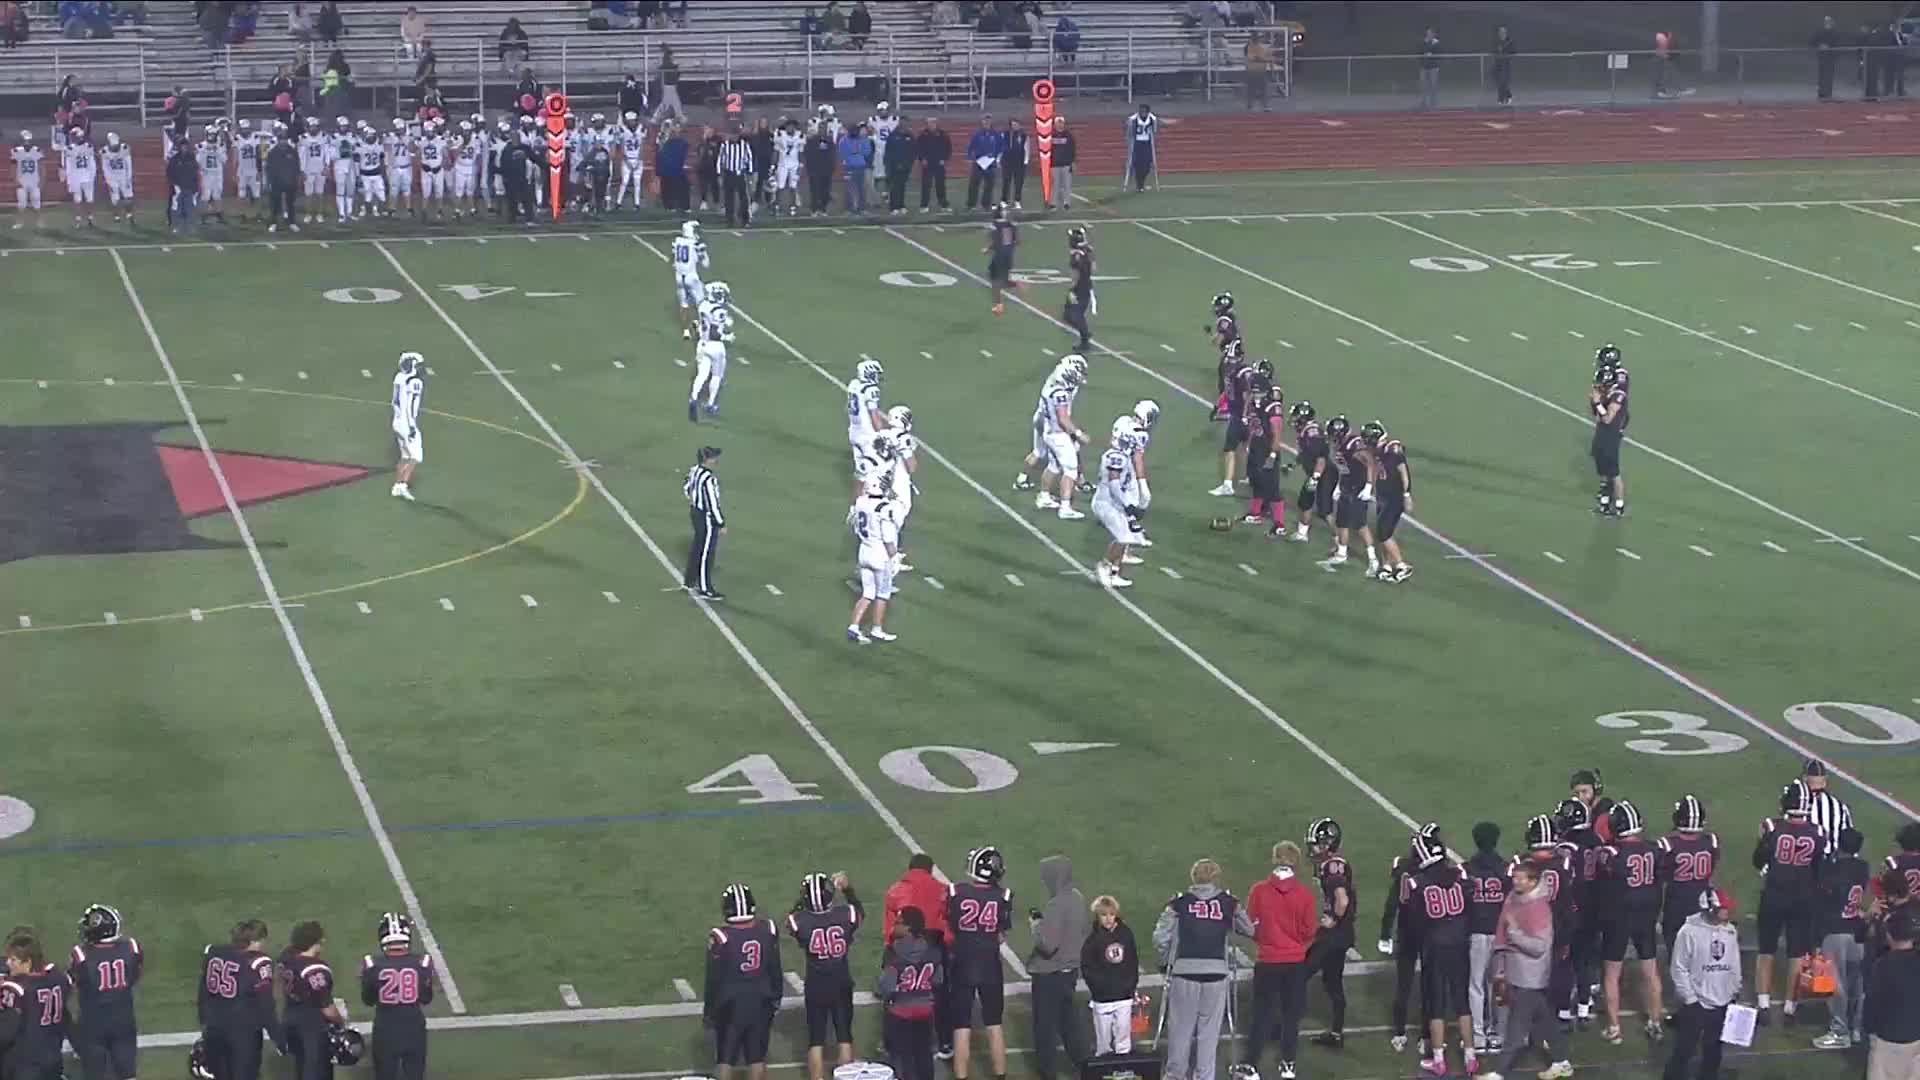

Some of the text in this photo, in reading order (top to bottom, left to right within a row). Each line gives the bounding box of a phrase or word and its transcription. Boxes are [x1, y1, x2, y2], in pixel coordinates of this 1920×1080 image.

[727, 93, 741, 112] 2
[685, 745, 1019, 804] 40
[1674, 850, 1712, 882] 20
[1775, 834, 1816, 866] 82
[1627, 851, 1655, 888] 31
[1424, 882, 1465, 918] 80
[1472, 877, 1504, 903] 12
[959, 899, 998, 932] 24
[740, 939, 761, 972] 3
[809, 925, 846, 960] 46
[98, 959, 126, 991] 11
[207, 957, 240, 998] 65
[378, 967, 418, 1004] 28
[37, 985, 62, 1026] 71
